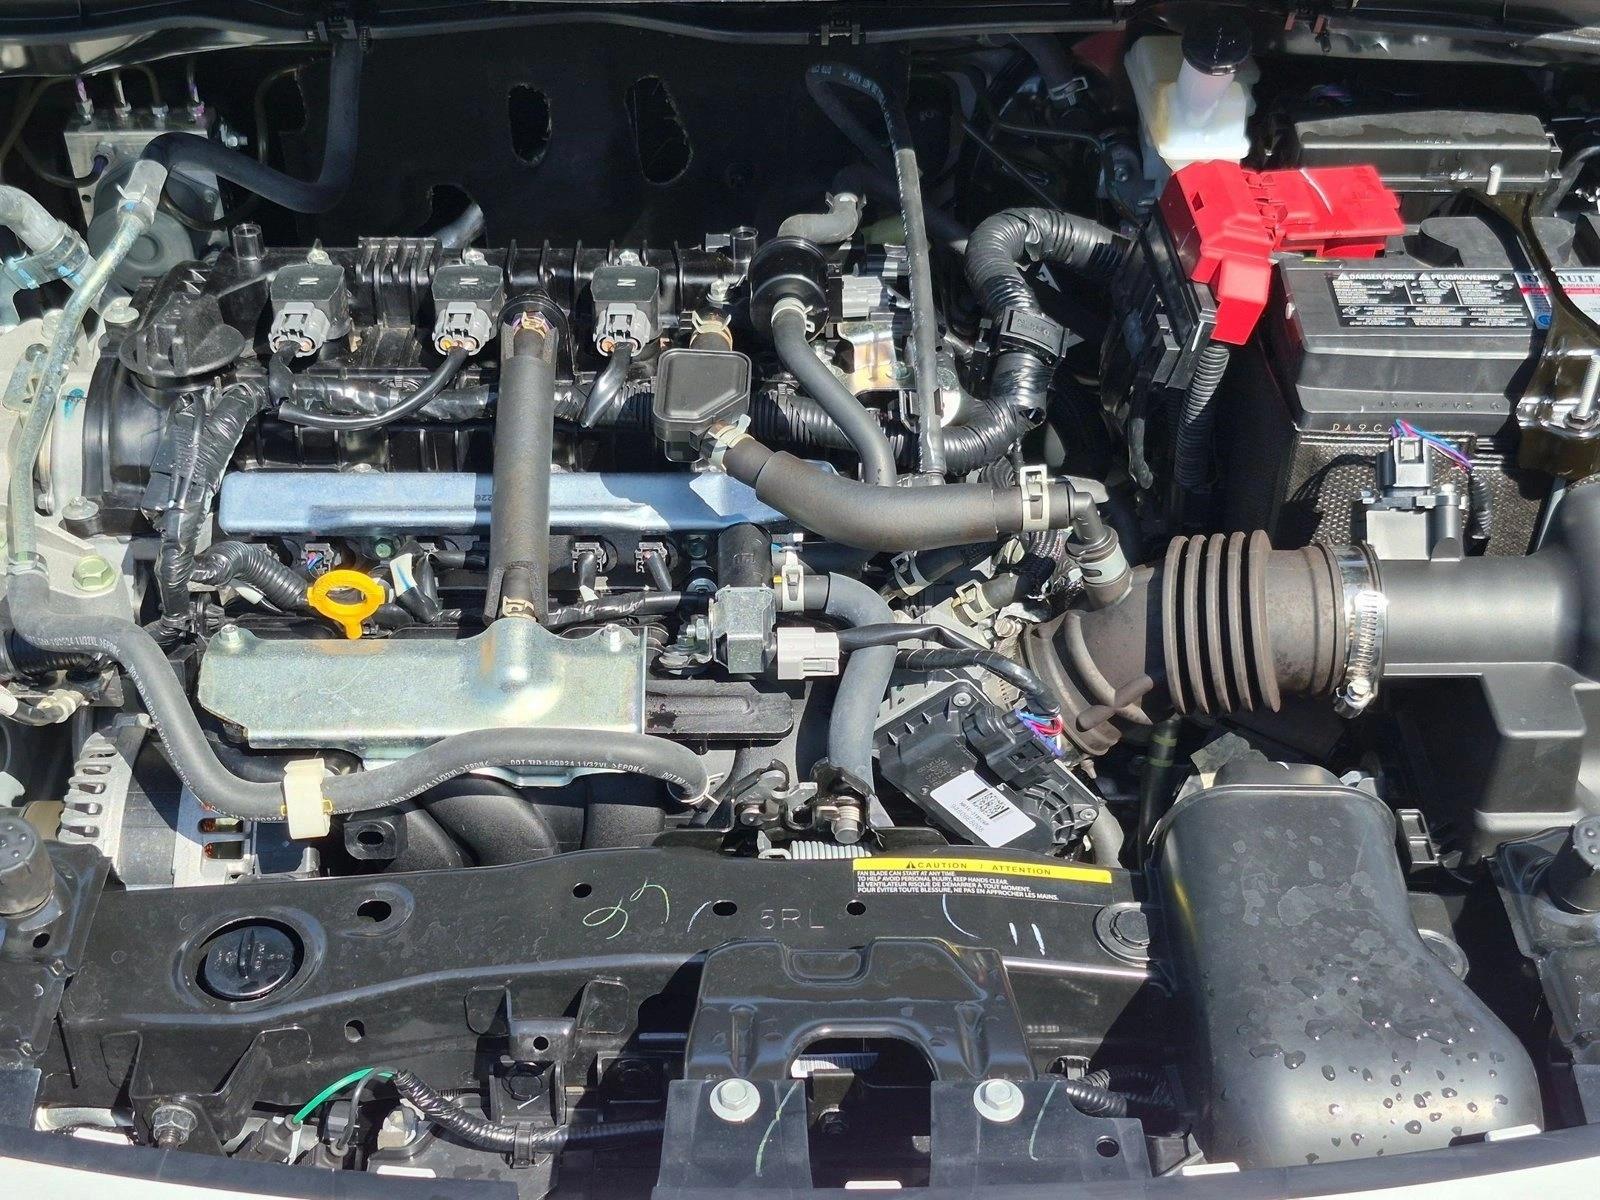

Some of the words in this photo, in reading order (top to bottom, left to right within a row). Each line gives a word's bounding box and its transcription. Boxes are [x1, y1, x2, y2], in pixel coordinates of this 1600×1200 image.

[917, 861, 967, 869] CAUTION
[992, 864, 1051, 875] ATTENTION
[986, 889, 1024, 898] APPROCHER
[759, 907, 825, 930] 5RL
